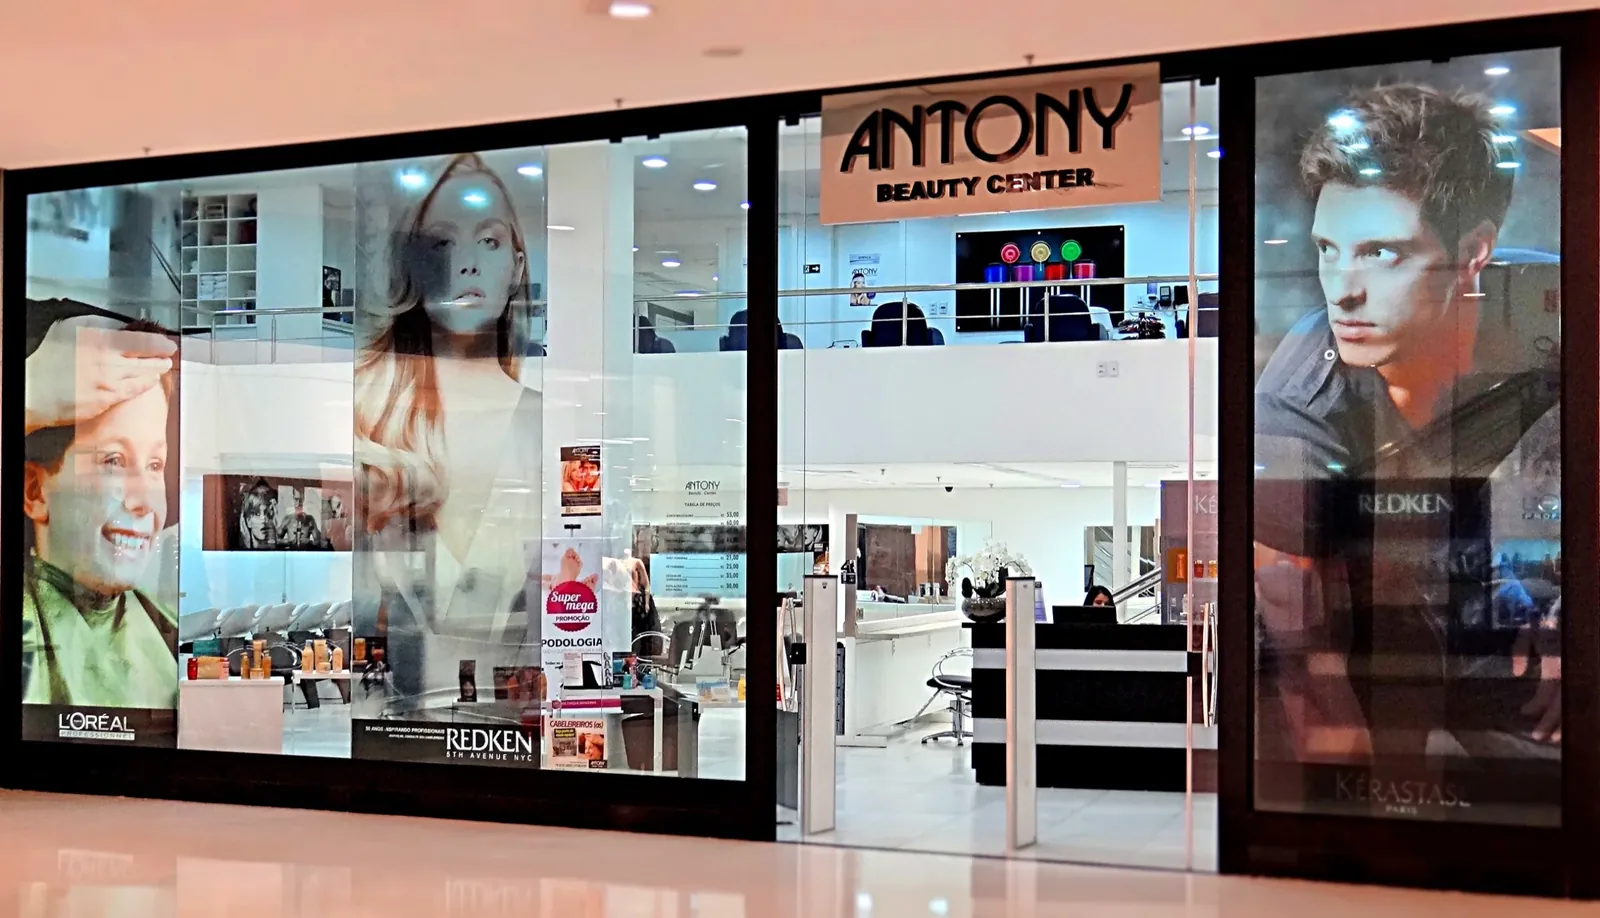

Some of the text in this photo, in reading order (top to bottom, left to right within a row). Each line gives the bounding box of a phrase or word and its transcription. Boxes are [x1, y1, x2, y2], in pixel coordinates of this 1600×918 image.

[840, 83, 1134, 172] ANTONY
[877, 167, 1094, 202] BEAUTY CENTER
[684, 480, 721, 490] ANTONY
[1359, 493, 1453, 514] REDKEN
[551, 591, 581, 605] Super
[565, 601, 594, 613] mega
[555, 614, 590, 622] PROMOÇÃO
[541, 638, 602, 647] PODOLOGIA
[59, 712, 135, 732] L'ORÉAL
[549, 720, 593, 728] CABELEIREIROS
[446, 728, 532, 753] REDKEN
[470, 752, 507, 760] AVENUE
[513, 754, 532, 762] NYC
